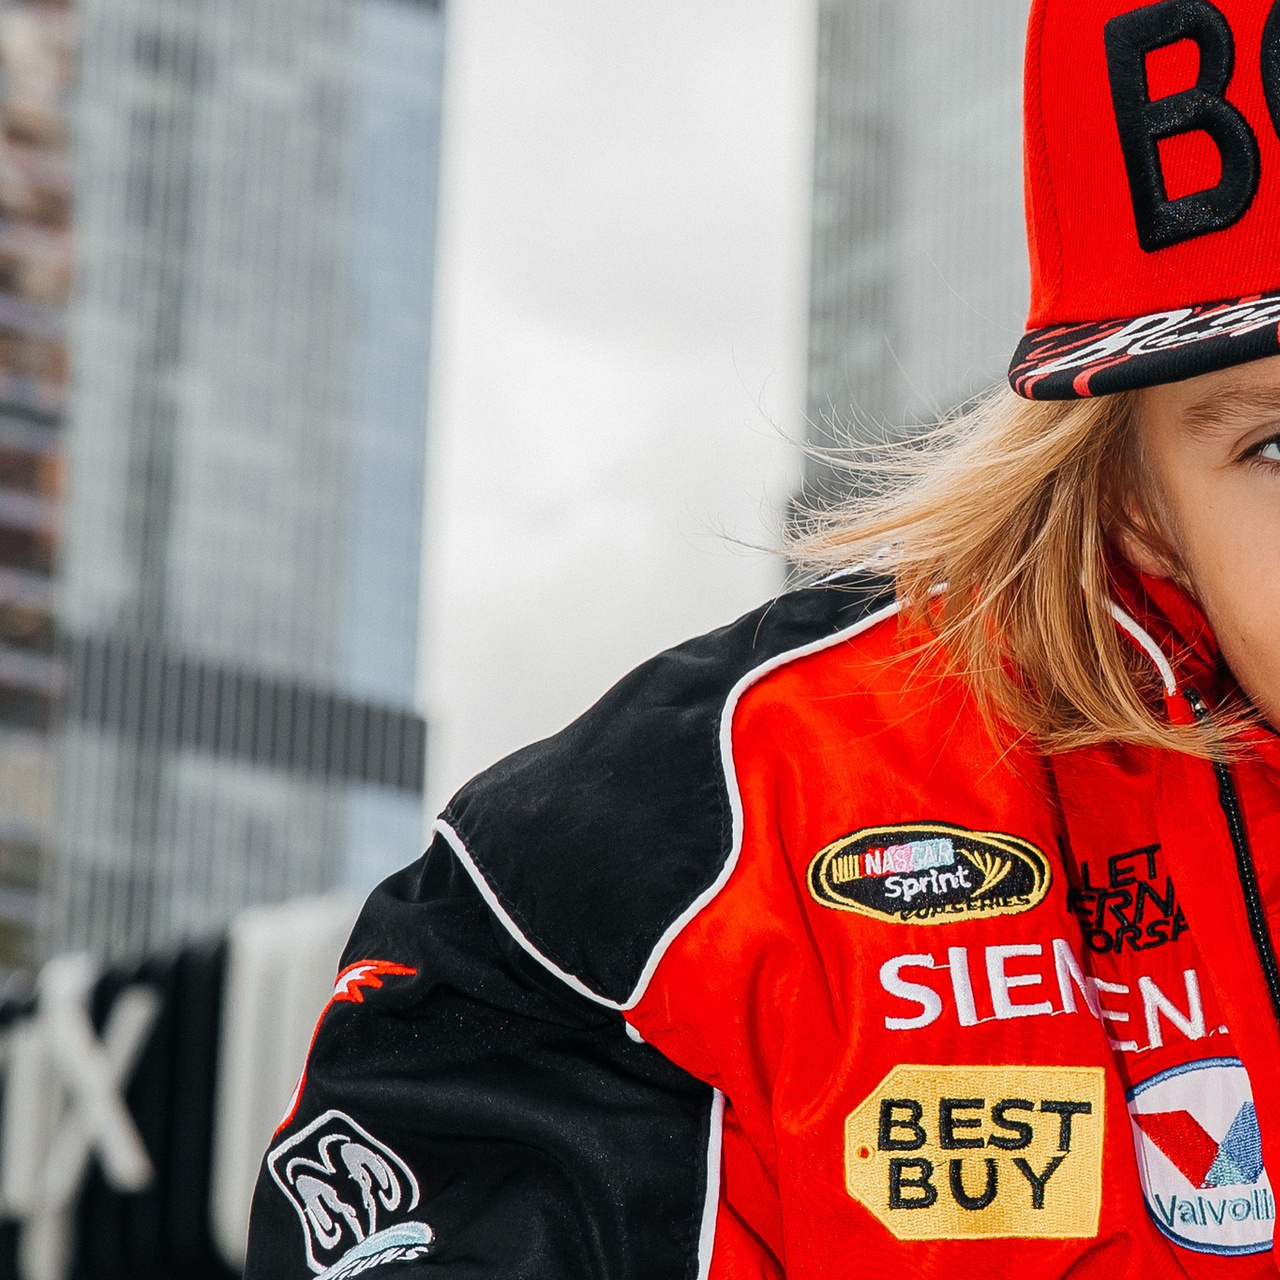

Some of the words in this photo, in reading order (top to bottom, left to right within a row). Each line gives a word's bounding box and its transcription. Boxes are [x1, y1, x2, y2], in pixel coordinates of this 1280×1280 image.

[864, 838, 954, 876] NASCAR
[884, 866, 972, 902] Sprint
[879, 938, 1229, 1054] SIEEN
[877, 1098, 1093, 1152] BEST
[889, 1157, 1068, 1210] BUY
[1154, 1188, 1275, 1228] Valvoli
